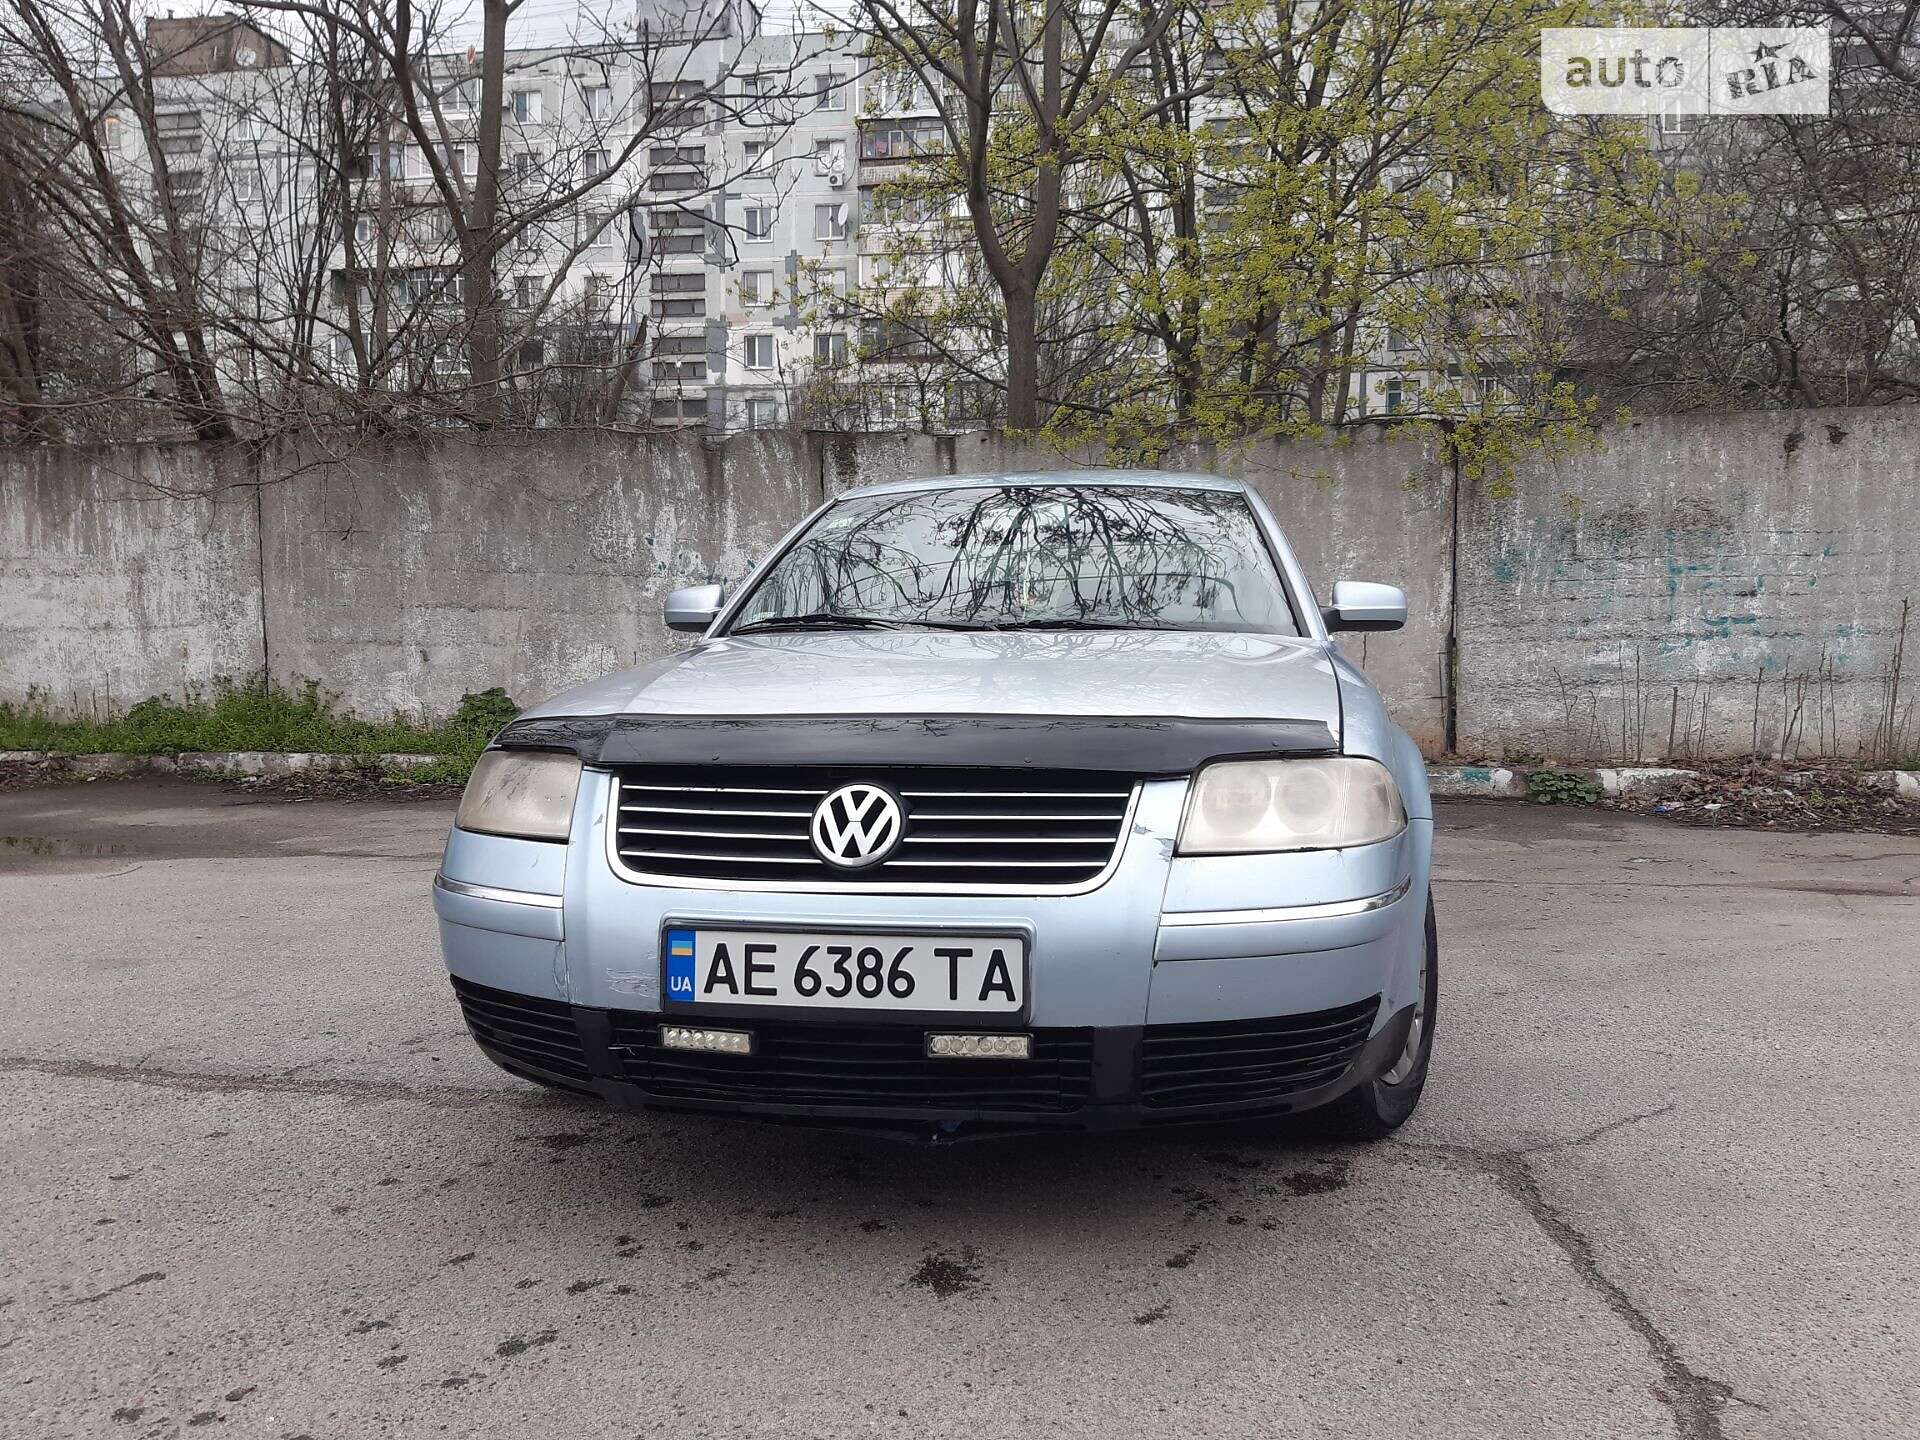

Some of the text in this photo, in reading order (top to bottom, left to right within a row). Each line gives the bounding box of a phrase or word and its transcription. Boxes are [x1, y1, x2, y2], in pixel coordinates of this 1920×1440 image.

[812, 784, 901, 866] VW
[670, 975, 692, 992] UA
[703, 942, 1017, 1003] AE 6386 TA
